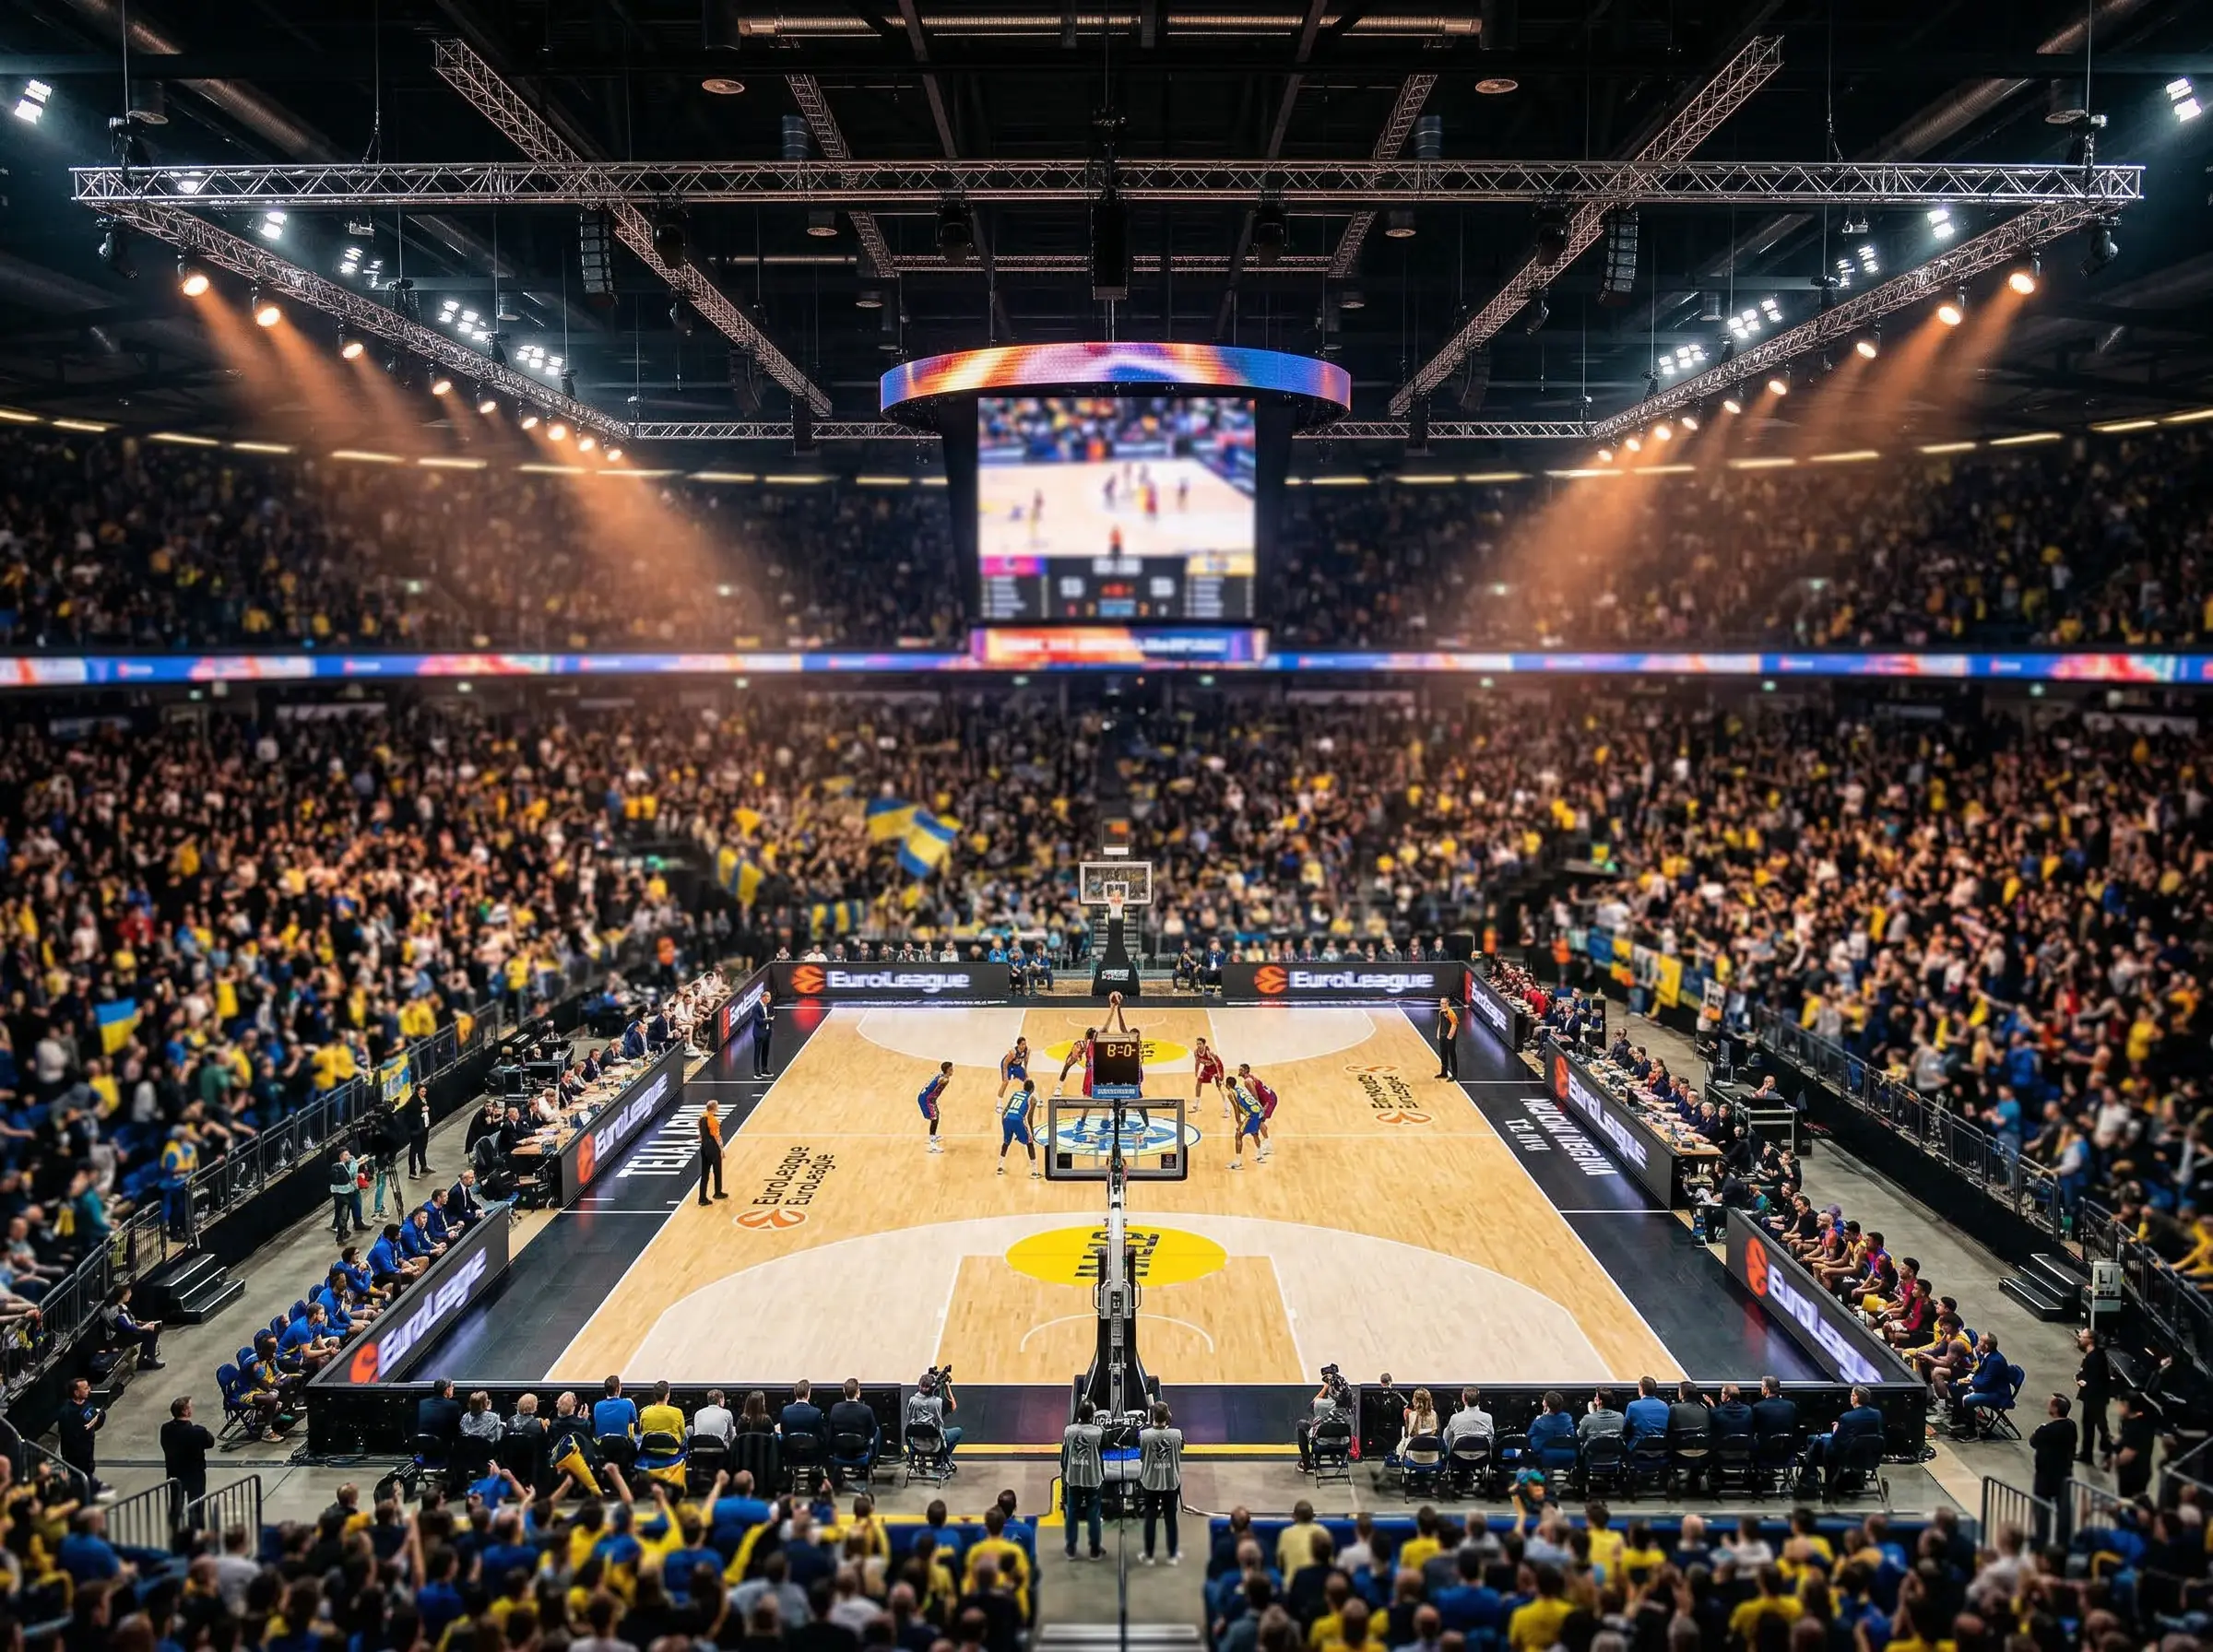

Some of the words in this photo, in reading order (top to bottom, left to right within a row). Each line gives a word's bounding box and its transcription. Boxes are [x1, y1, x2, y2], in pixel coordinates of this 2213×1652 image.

[827, 971, 971, 994] EuroLeague
[1289, 971, 1435, 994] EuroLeague
[752, 1146, 811, 1205] EuroLeague
[784, 1154, 836, 1205] EuroLeague
